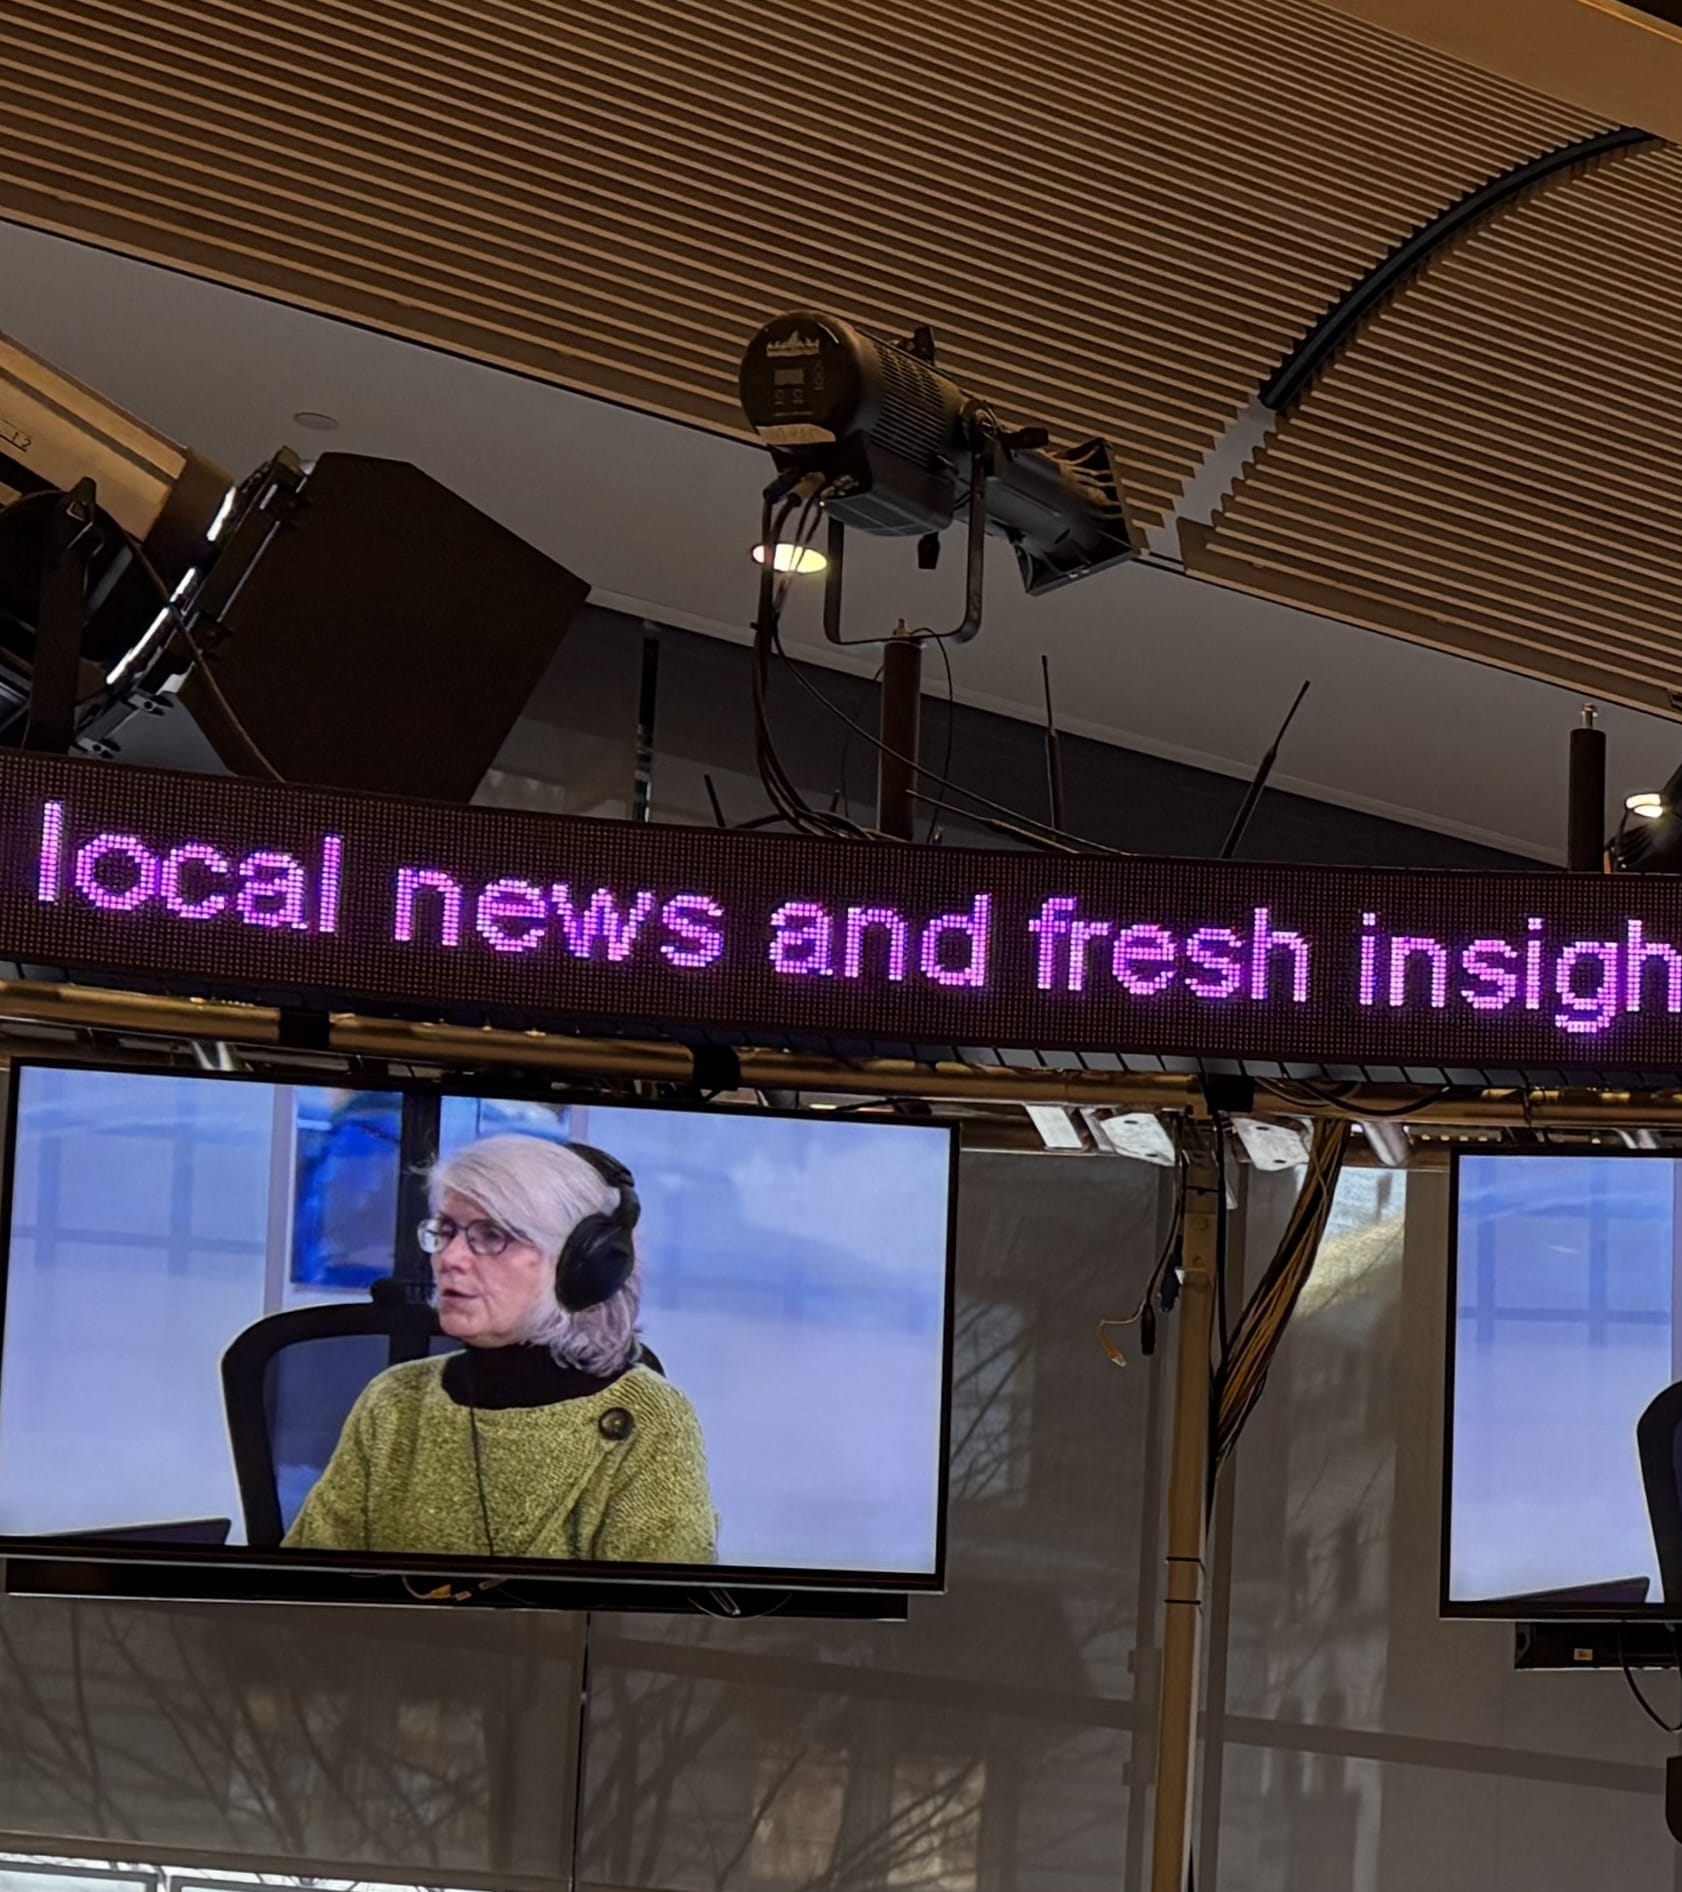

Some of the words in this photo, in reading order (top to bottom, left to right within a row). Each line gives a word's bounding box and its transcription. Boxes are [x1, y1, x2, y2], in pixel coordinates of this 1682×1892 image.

[39, 803, 340, 932] local
[395, 868, 723, 967] news
[769, 894, 989, 987] and
[1028, 897, 1308, 1001] fresh
